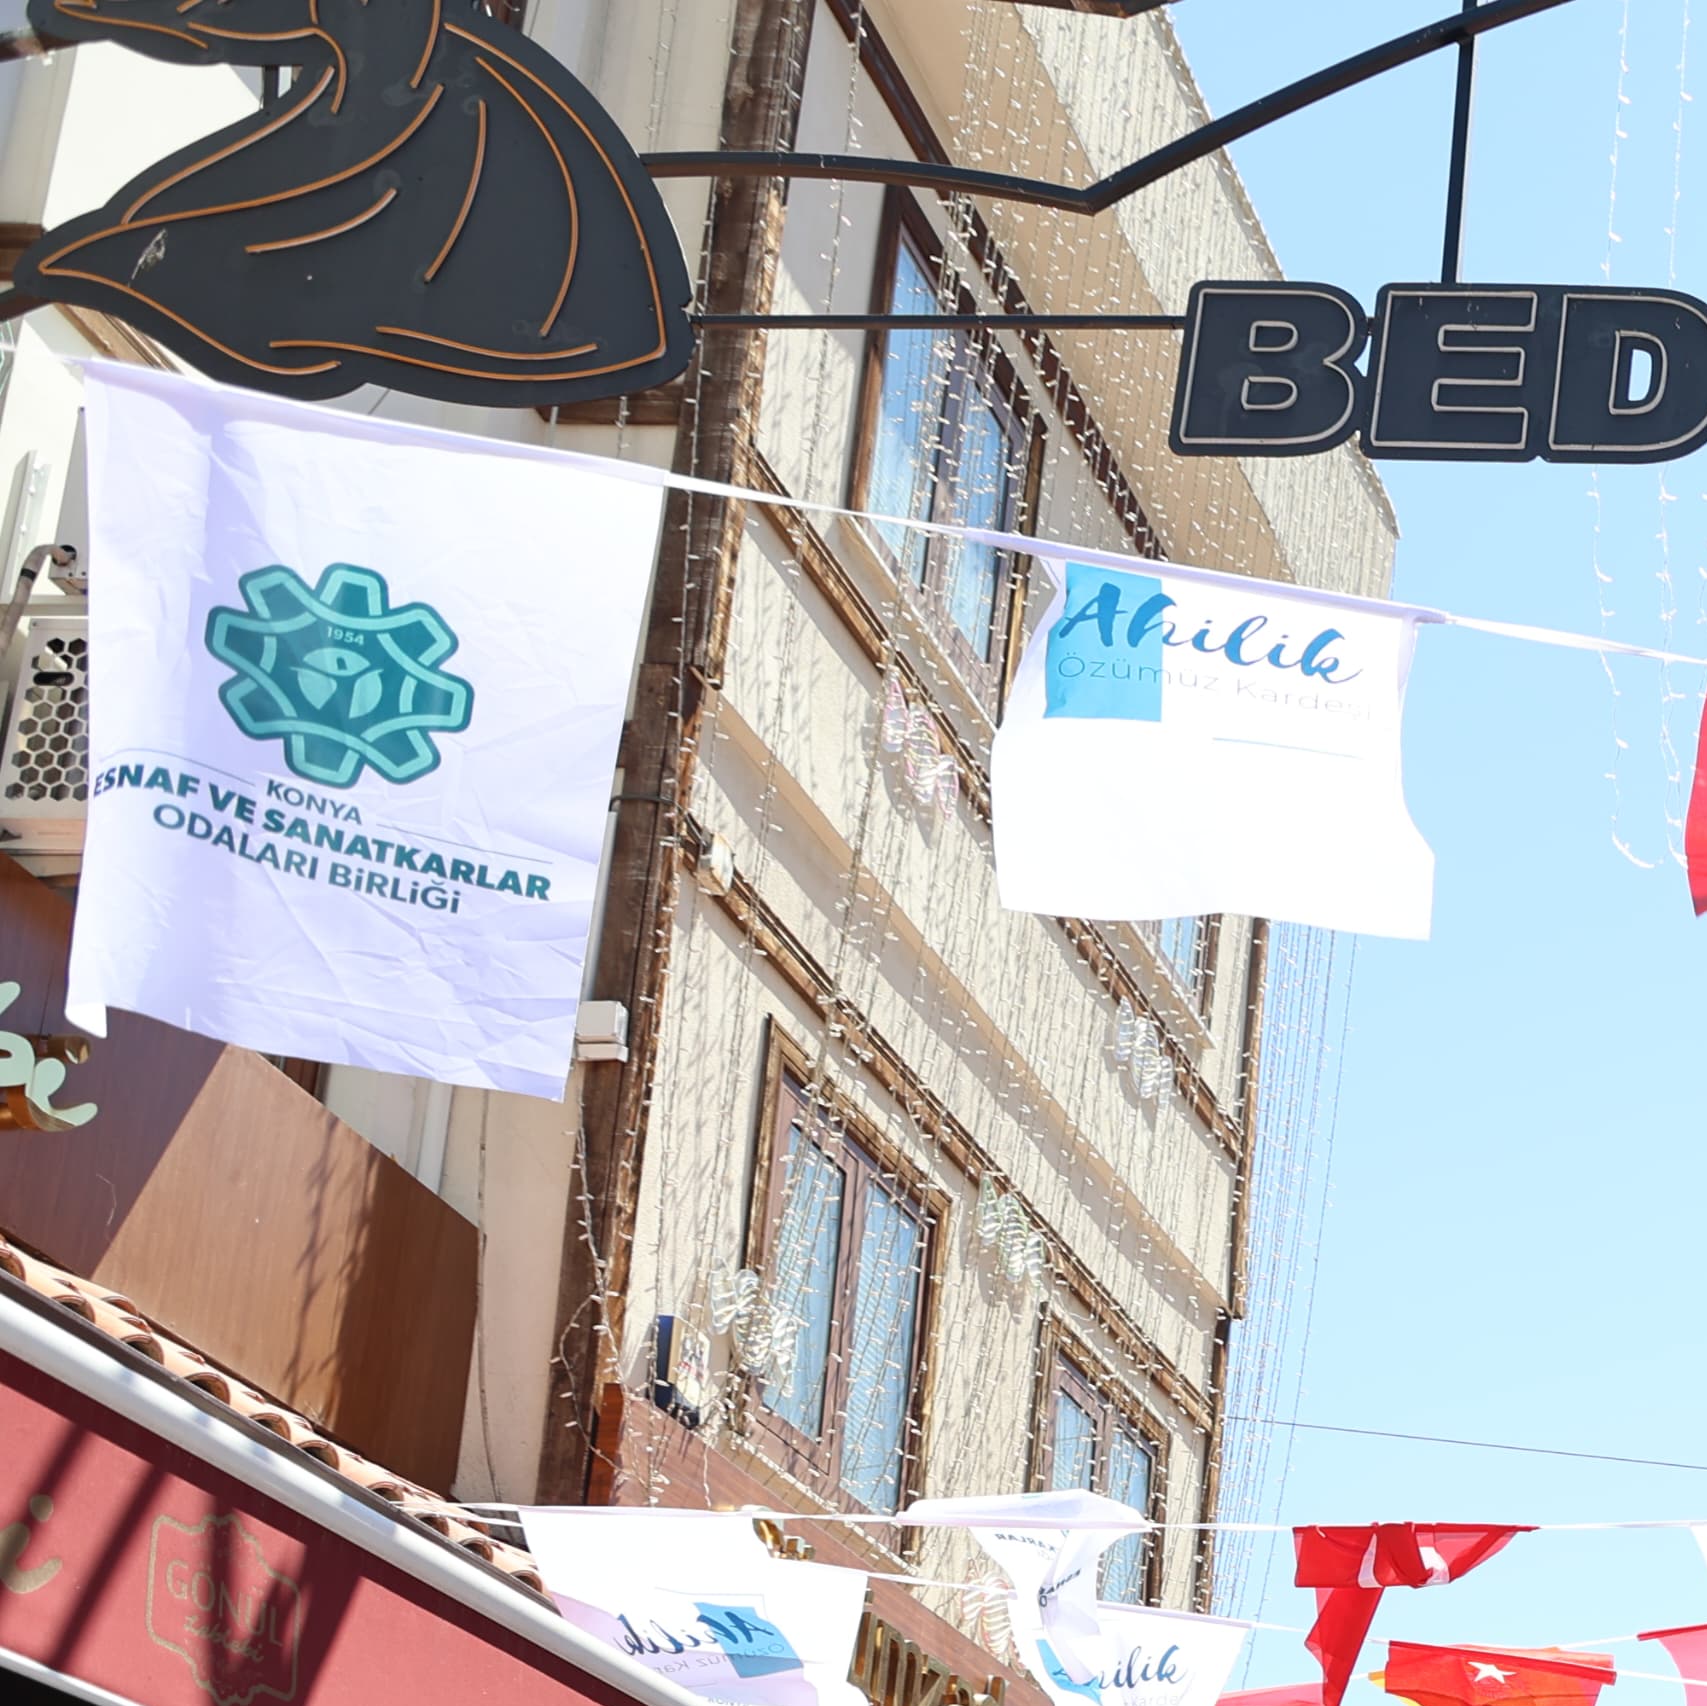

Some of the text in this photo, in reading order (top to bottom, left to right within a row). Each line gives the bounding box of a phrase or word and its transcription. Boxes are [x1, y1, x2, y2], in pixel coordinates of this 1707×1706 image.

[326, 625, 365, 647] 1954
[1058, 582, 1363, 684] Ahilik
[1058, 652, 1219, 692] Özümüz
[93, 763, 553, 902] ESNAF VE SANATKARLAR
[266, 779, 363, 826] KONYA
[152, 804, 319, 881] ODALARI
[166, 1558, 284, 1647] GÖNÜL
